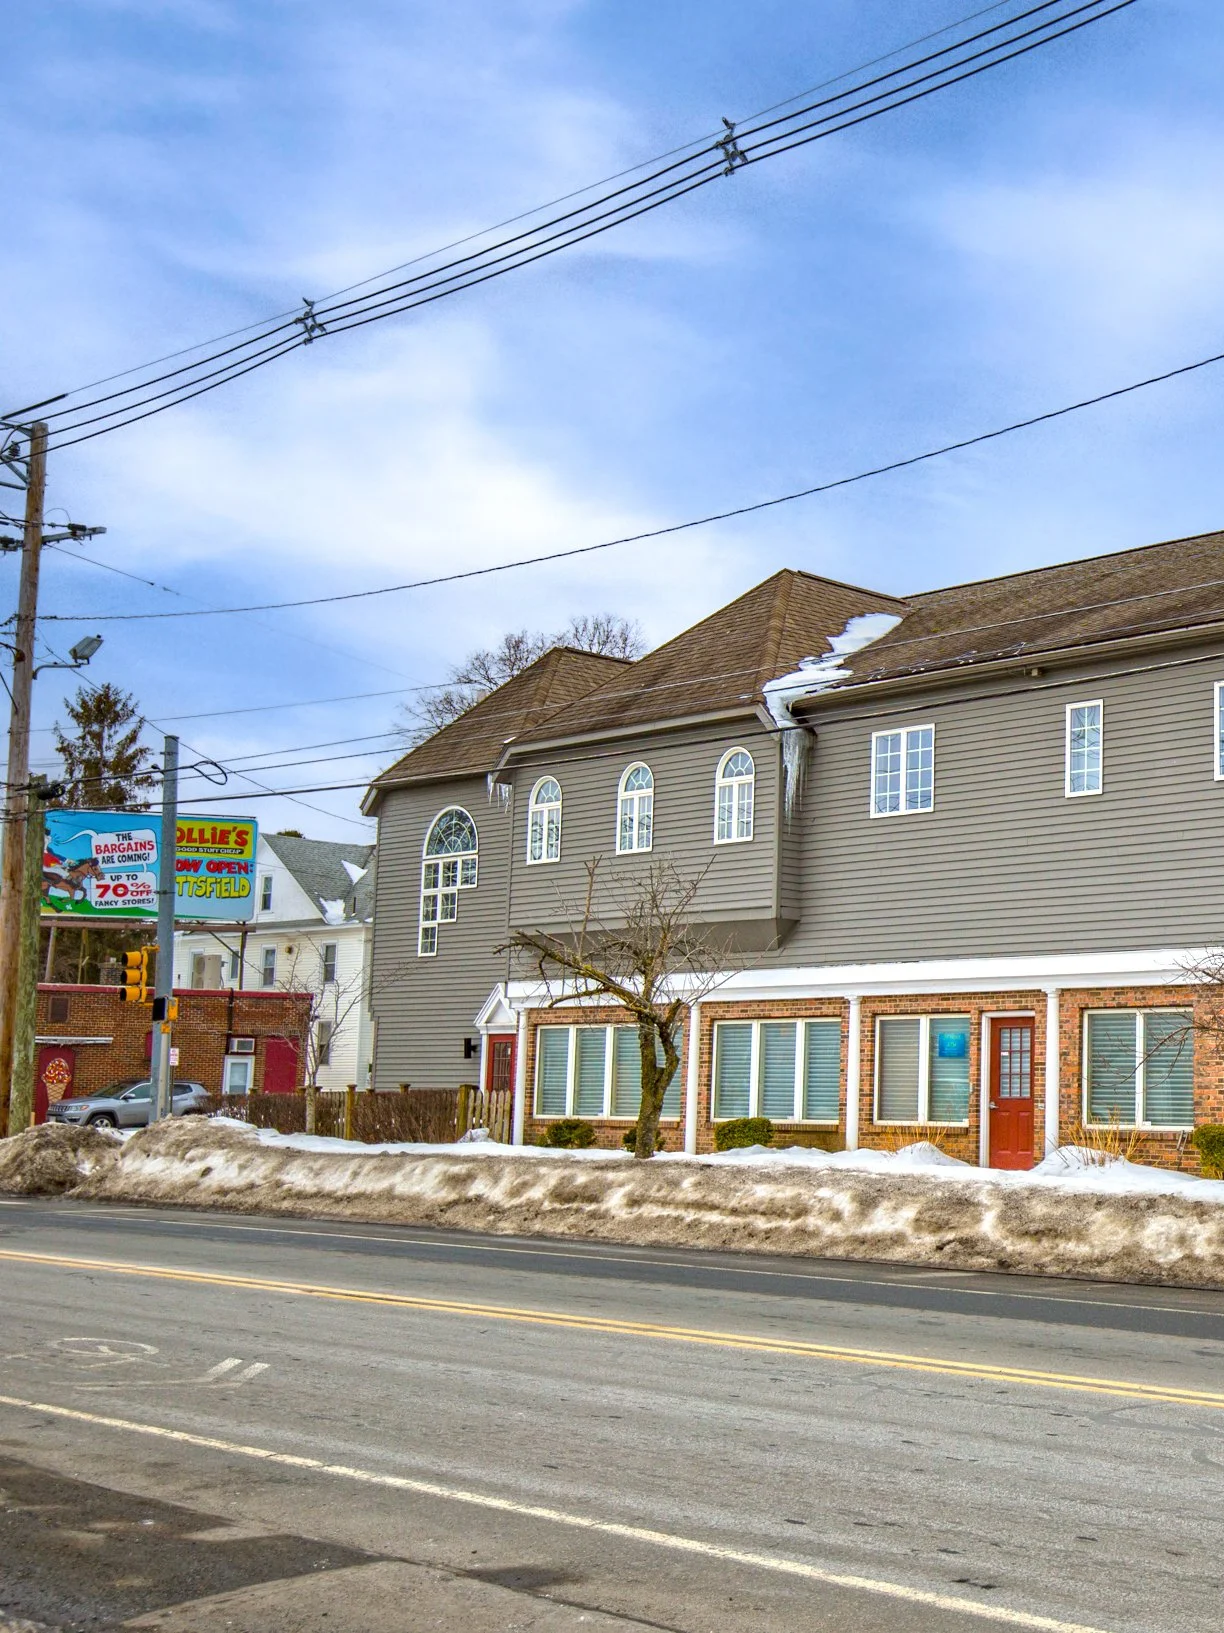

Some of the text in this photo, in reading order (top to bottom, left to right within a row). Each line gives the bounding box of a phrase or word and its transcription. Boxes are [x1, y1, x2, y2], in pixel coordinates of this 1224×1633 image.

[115, 832, 133, 841] THE
[95, 840, 155, 855] BARGAINS
[101, 853, 150, 865] ARE COMING!
[176, 859, 254, 874] OW OPEN:
[125, 873, 138, 881] TO
[95, 883, 129, 899] 70
[175, 875, 251, 898] TTSFIELD
[121, 898, 154, 906] STORES!
